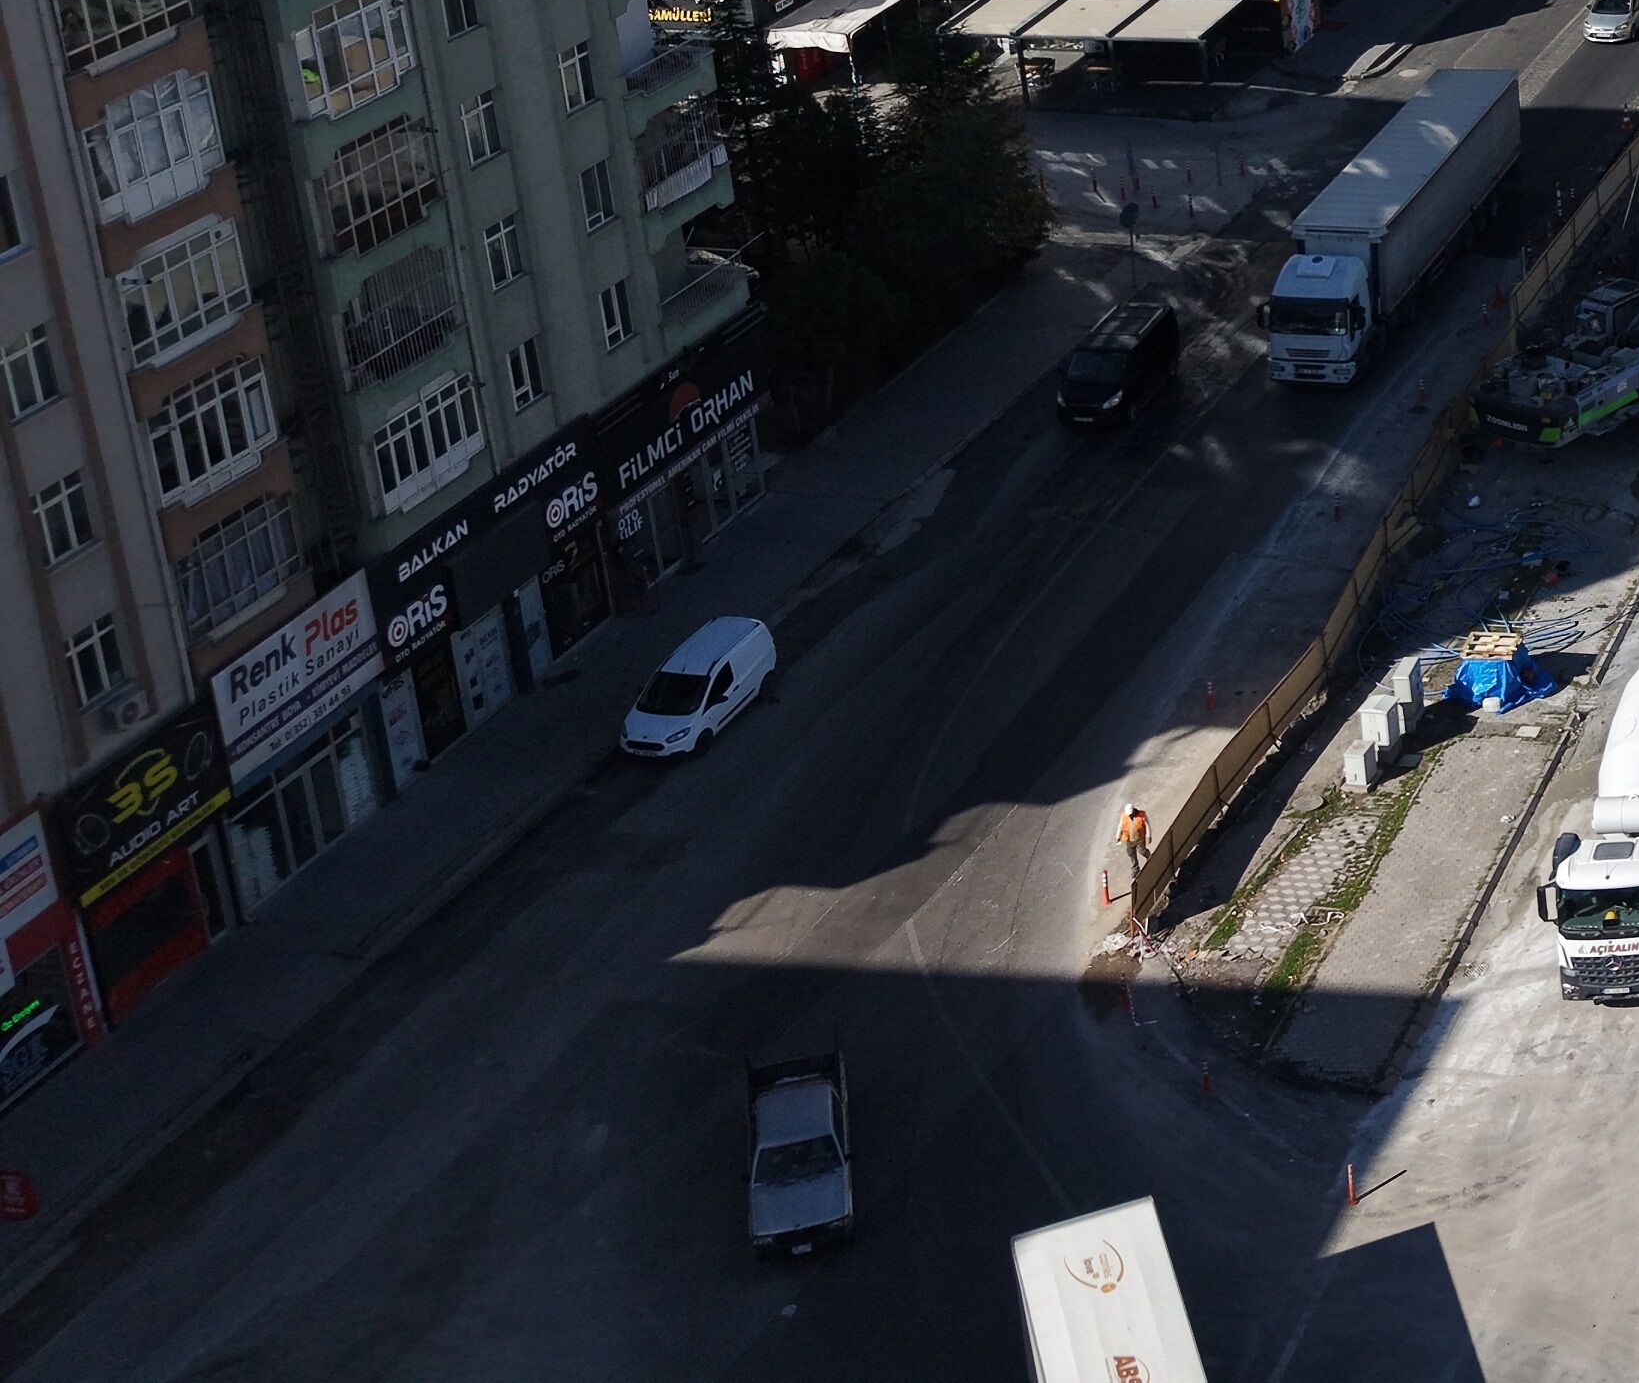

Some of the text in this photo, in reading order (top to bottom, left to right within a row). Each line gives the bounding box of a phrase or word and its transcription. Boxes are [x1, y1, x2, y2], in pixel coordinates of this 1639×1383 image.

[690, 370, 754, 434] ORHAN
[1485, 414, 1528, 432] ZOOMLION
[493, 441, 578, 514] RADYATÖR
[398, 518, 469, 584] BALKAN
[618, 508, 640, 530] OTO
[229, 598, 359, 704] Renk Plas
[239, 623, 361, 727] Plastik Sanayi
[395, 647, 411, 664] OTO
[109, 789, 200, 869] AUDIO ART
